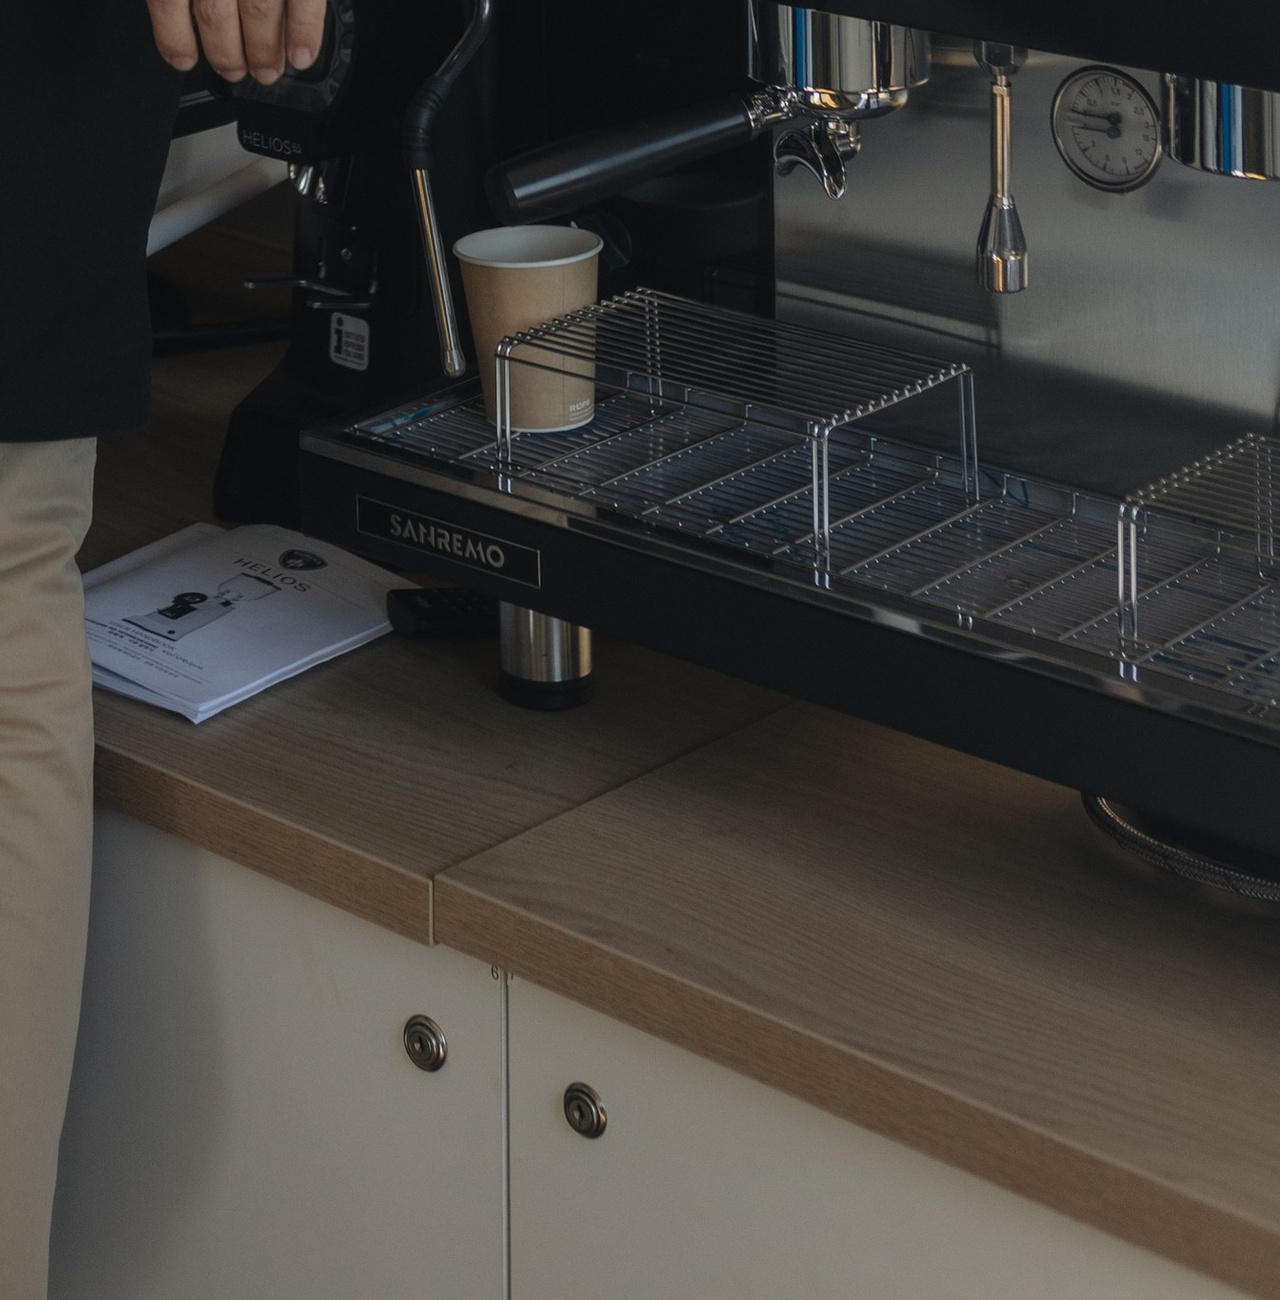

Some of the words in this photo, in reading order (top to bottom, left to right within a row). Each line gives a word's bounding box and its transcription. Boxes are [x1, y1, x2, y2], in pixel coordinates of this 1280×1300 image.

[242, 129, 292, 155] HELIOS
[389, 513, 506, 568] SANREMO
[232, 557, 312, 593] HELIOS
